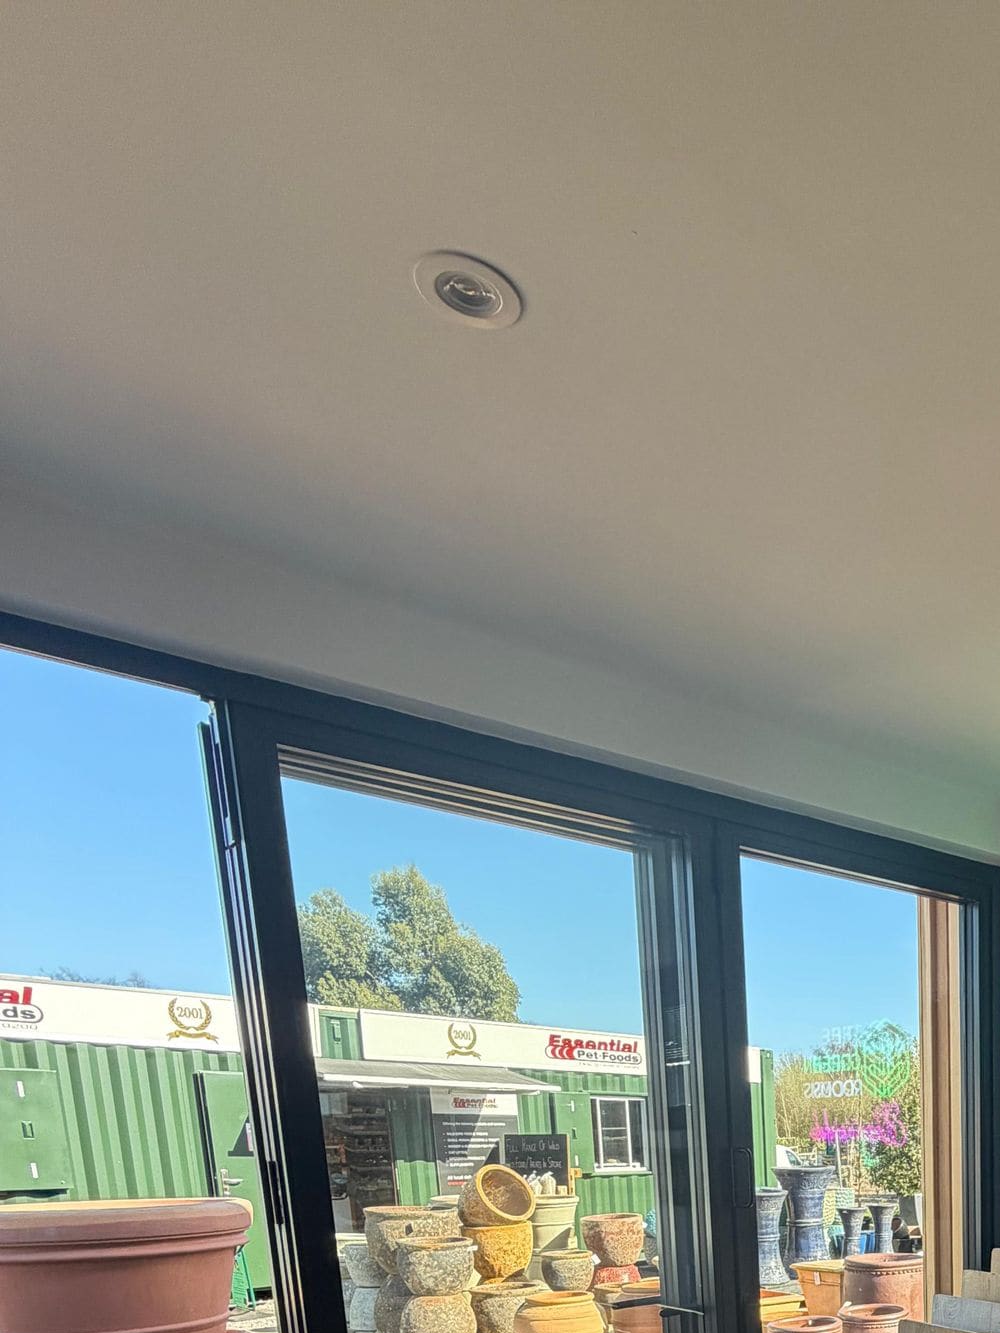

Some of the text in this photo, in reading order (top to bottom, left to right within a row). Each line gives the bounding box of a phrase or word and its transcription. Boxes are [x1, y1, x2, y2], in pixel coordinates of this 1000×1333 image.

[176, 1005, 204, 1020] 2001
[453, 1029, 472, 1041] 2001
[549, 1034, 638, 1053] Essential
